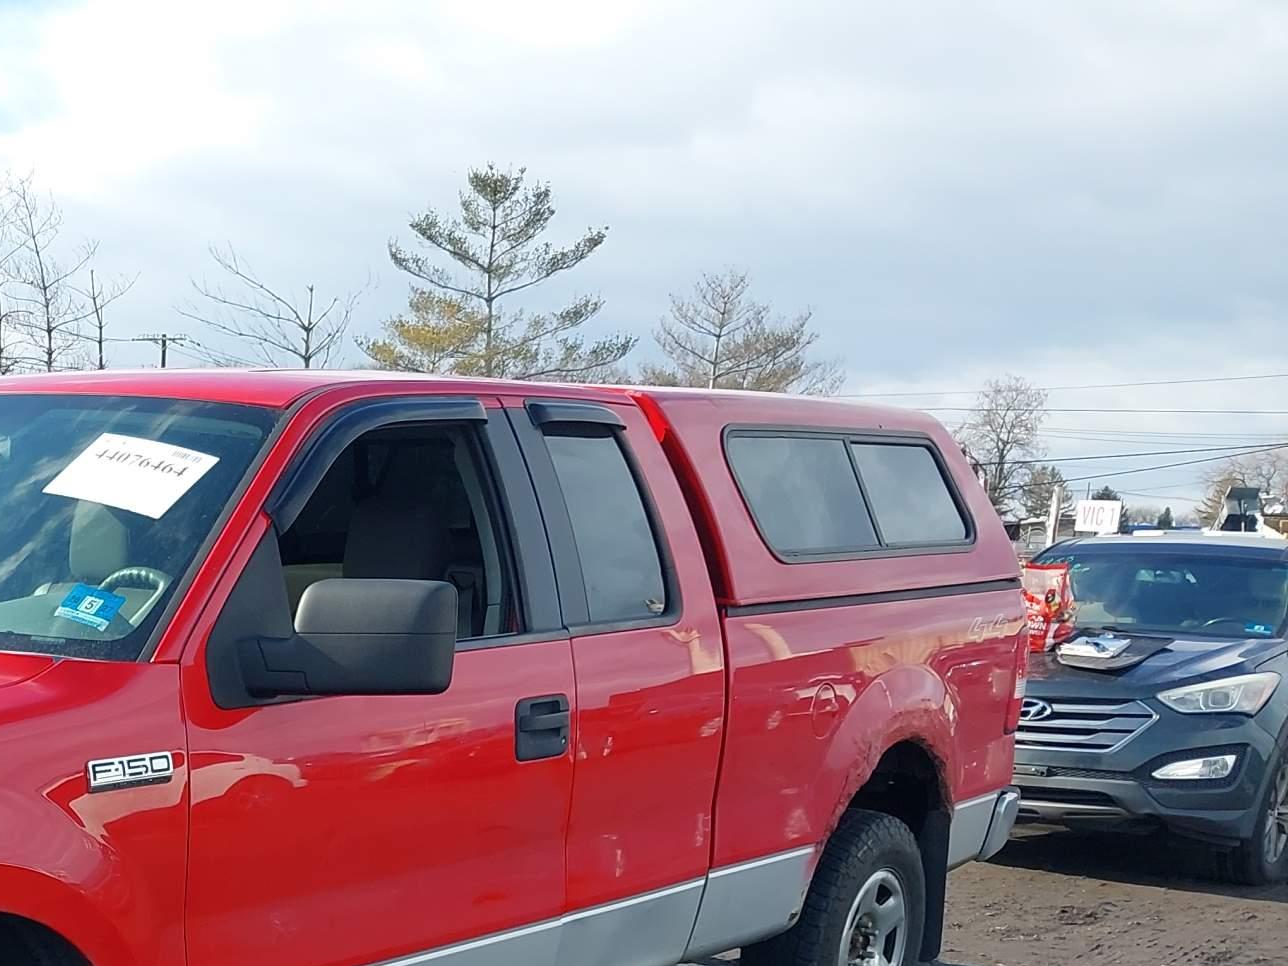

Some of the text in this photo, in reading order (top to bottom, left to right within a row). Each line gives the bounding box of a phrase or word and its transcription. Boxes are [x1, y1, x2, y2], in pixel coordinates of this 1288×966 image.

[96, 449, 188, 477] 44076464
[1083, 506, 1105, 526] VIC
[84, 600, 97, 610] 5
